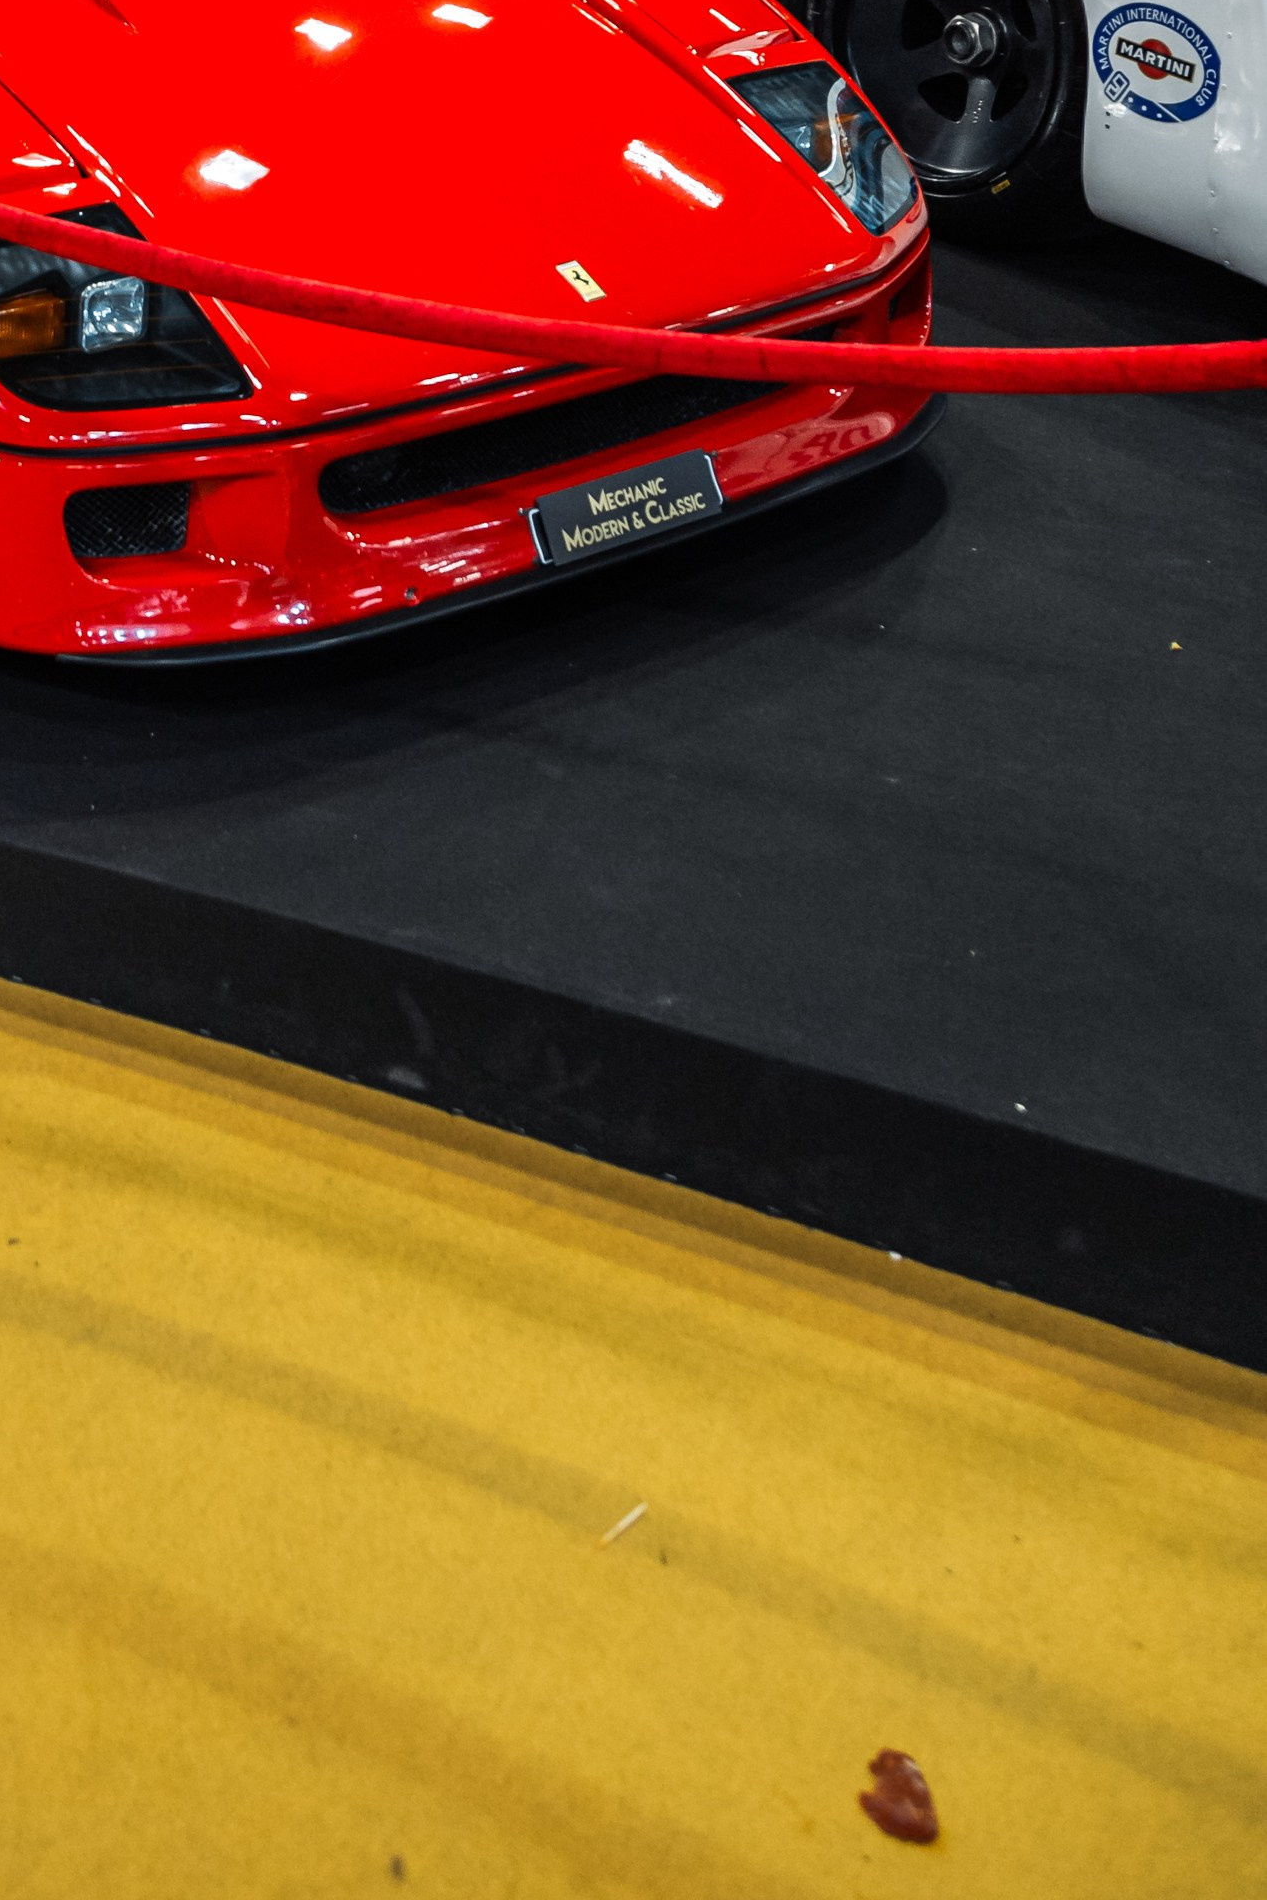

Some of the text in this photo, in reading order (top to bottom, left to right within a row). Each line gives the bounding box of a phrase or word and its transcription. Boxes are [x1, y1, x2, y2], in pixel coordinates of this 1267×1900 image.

[1097, 7, 1217, 106] MARTINI INTERNATIONAL CLUB
[1120, 41, 1190, 78] MARTINI
[587, 476, 668, 516] MECHANIC
[561, 491, 707, 552] MODERN & CLASSIC
